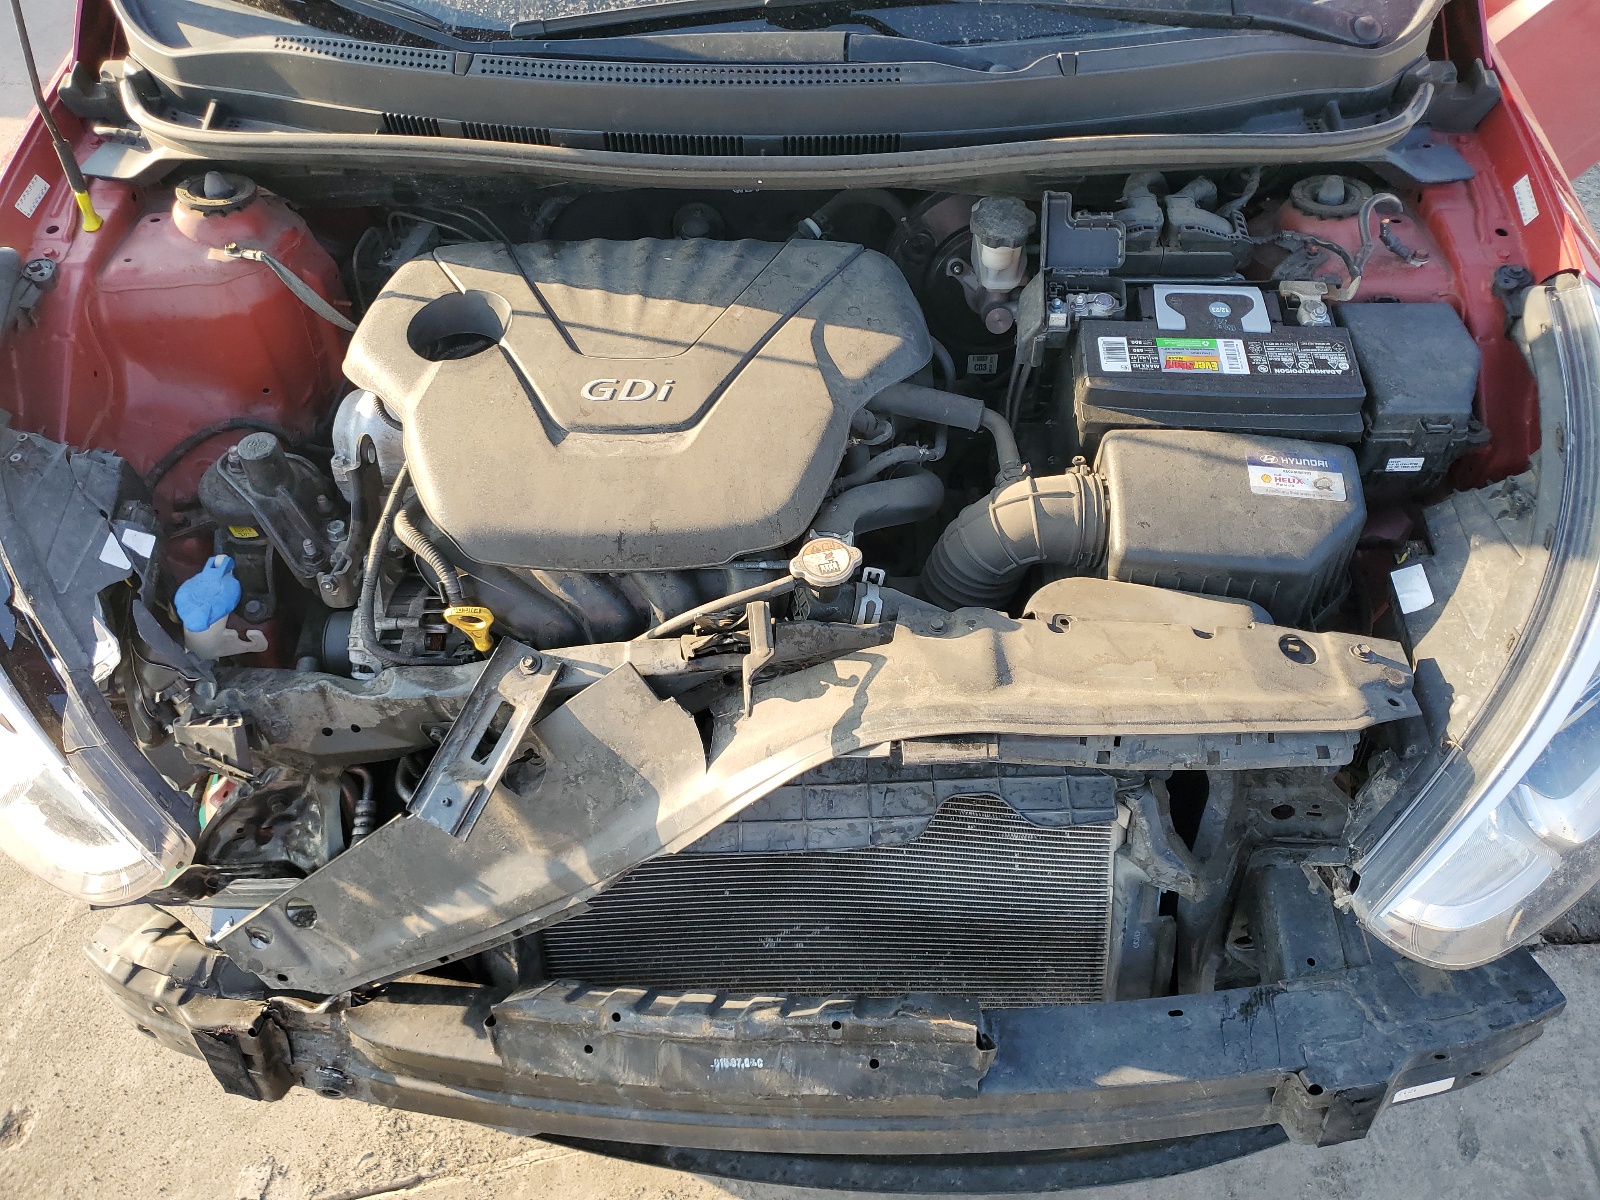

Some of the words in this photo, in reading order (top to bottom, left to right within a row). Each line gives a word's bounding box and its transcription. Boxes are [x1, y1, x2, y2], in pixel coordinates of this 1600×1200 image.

[1211, 306, 1230, 314] 12/23
[973, 363, 987, 372] C03
[1164, 360, 1219, 372] EverStart
[580, 378, 677, 402] GDi
[1281, 456, 1329, 468] HYUNDAI
[1274, 476, 1304, 485] HELIX
